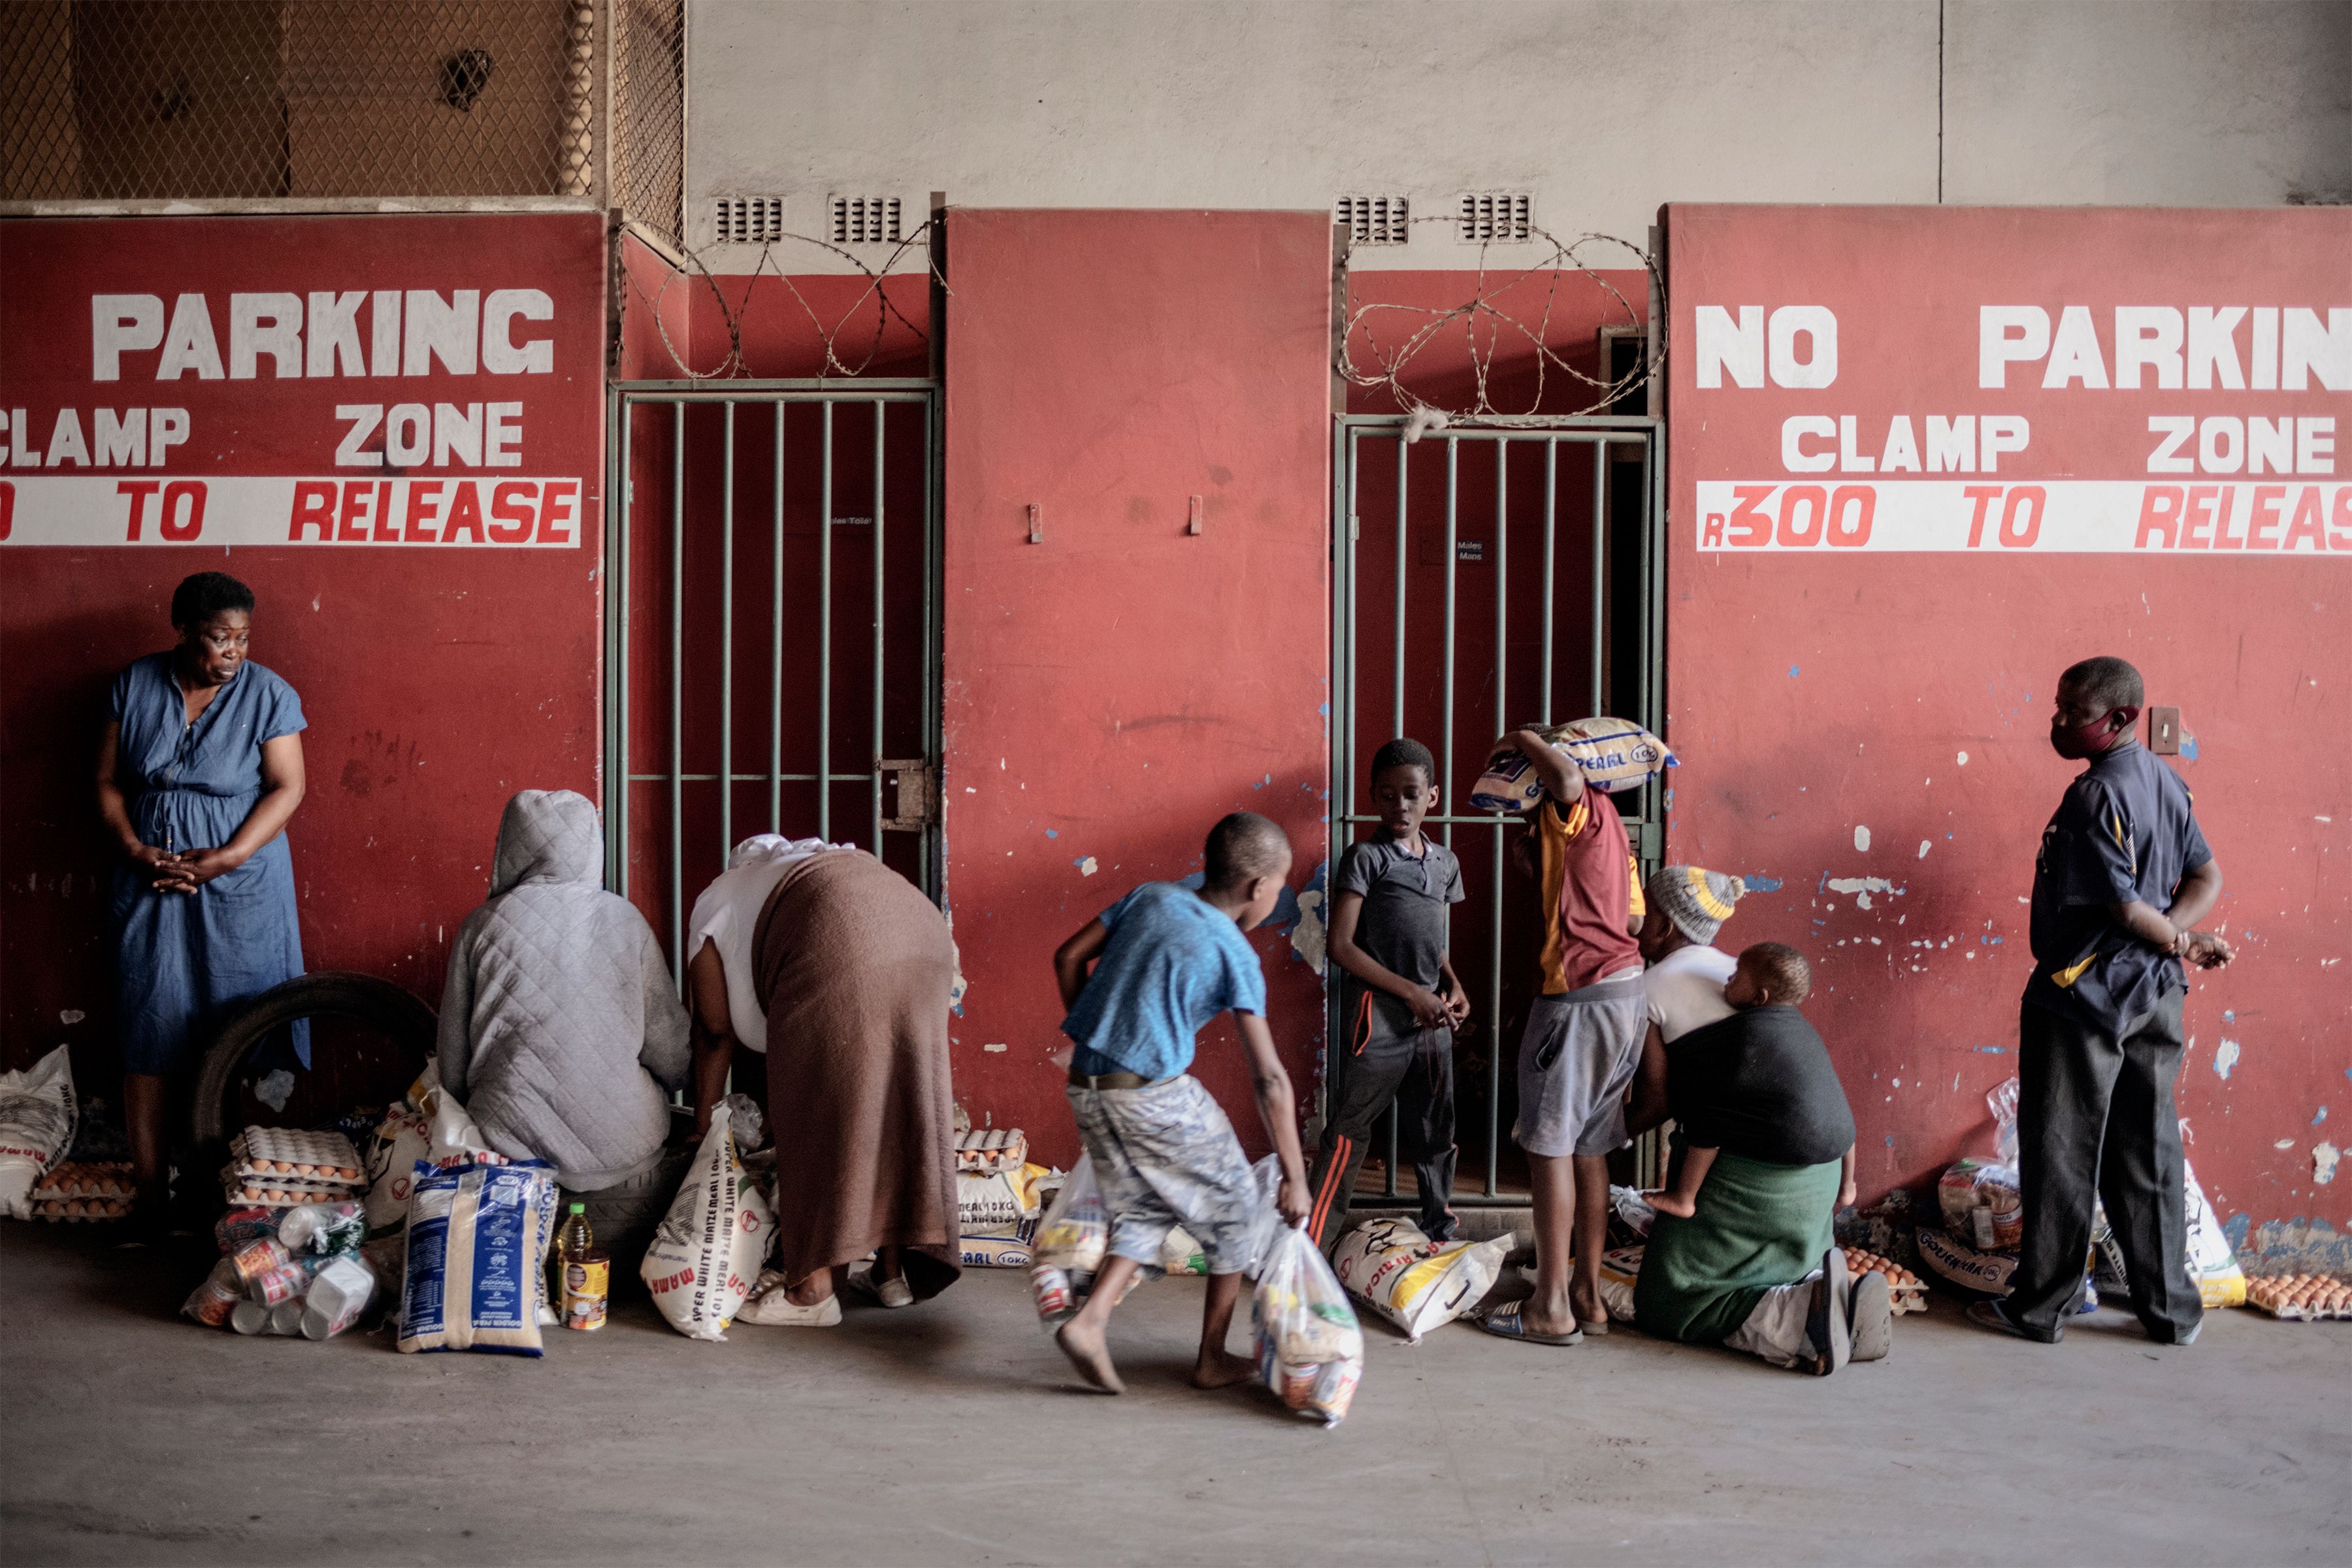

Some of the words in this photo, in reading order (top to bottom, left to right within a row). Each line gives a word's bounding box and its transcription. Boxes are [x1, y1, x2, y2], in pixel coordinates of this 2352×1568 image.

[92, 289, 555, 381] PARKING
[1695, 305, 1838, 389] NO
[1979, 305, 2352, 391] PARKIN
[0, 408, 190, 467] LAMP
[335, 402, 523, 467] ZONE
[1781, 415, 2030, 473] CLAMP
[2147, 416, 2335, 474] ZONE
[117, 480, 208, 542] TO
[288, 481, 578, 544] RELEASE
[1702, 485, 1876, 547] R300
[1963, 485, 2046, 548] TO
[1460, 552, 1482, 561] Mans
[724, 1177, 734, 1213] WHITE
[986, 1201, 1015, 1212] 10KG
[696, 1248, 712, 1287] WHITE
[704, 1209, 717, 1243] MAIZE
[719, 1217, 733, 1256] MAIZE
[959, 1252, 993, 1265] ARL
[1001, 1256, 1028, 1264] 10KG
[652, 1267, 694, 1294] MAMA
[715, 1260, 728, 1292] MEAL
